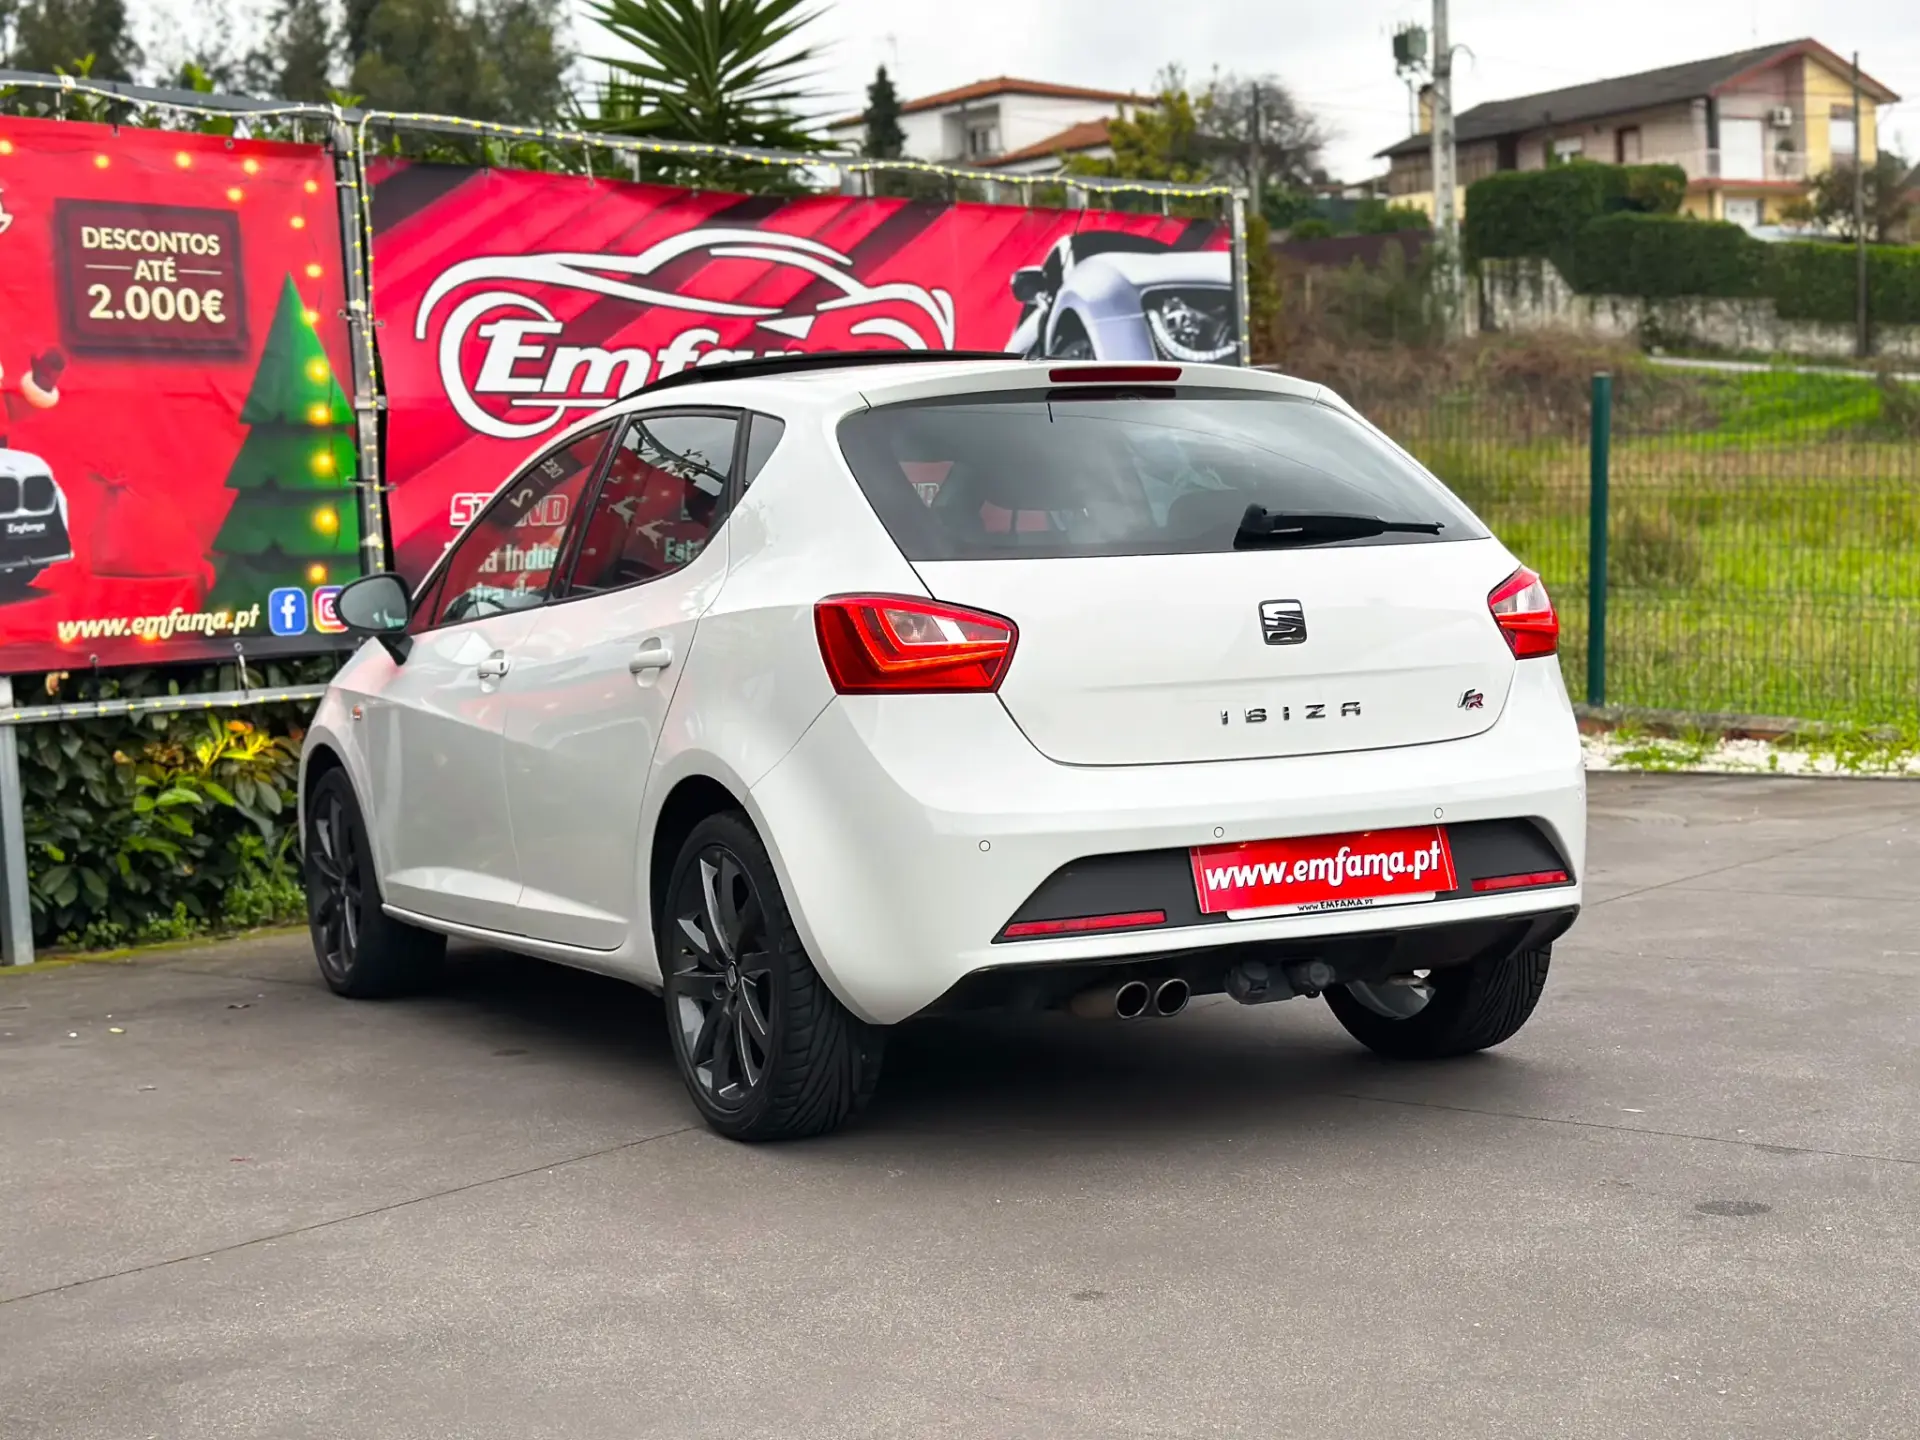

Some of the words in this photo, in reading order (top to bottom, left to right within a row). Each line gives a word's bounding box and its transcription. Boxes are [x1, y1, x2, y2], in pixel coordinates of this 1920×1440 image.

[81, 226, 220, 256] DESCONTOS
[134, 257, 177, 282] ATÉ
[87, 284, 225, 323] 2.000€
[57, 604, 260, 639] www.emfama.pt
[1220, 701, 1362, 725] IBIZA
[1205, 840, 1441, 892] www.emfama.pt
